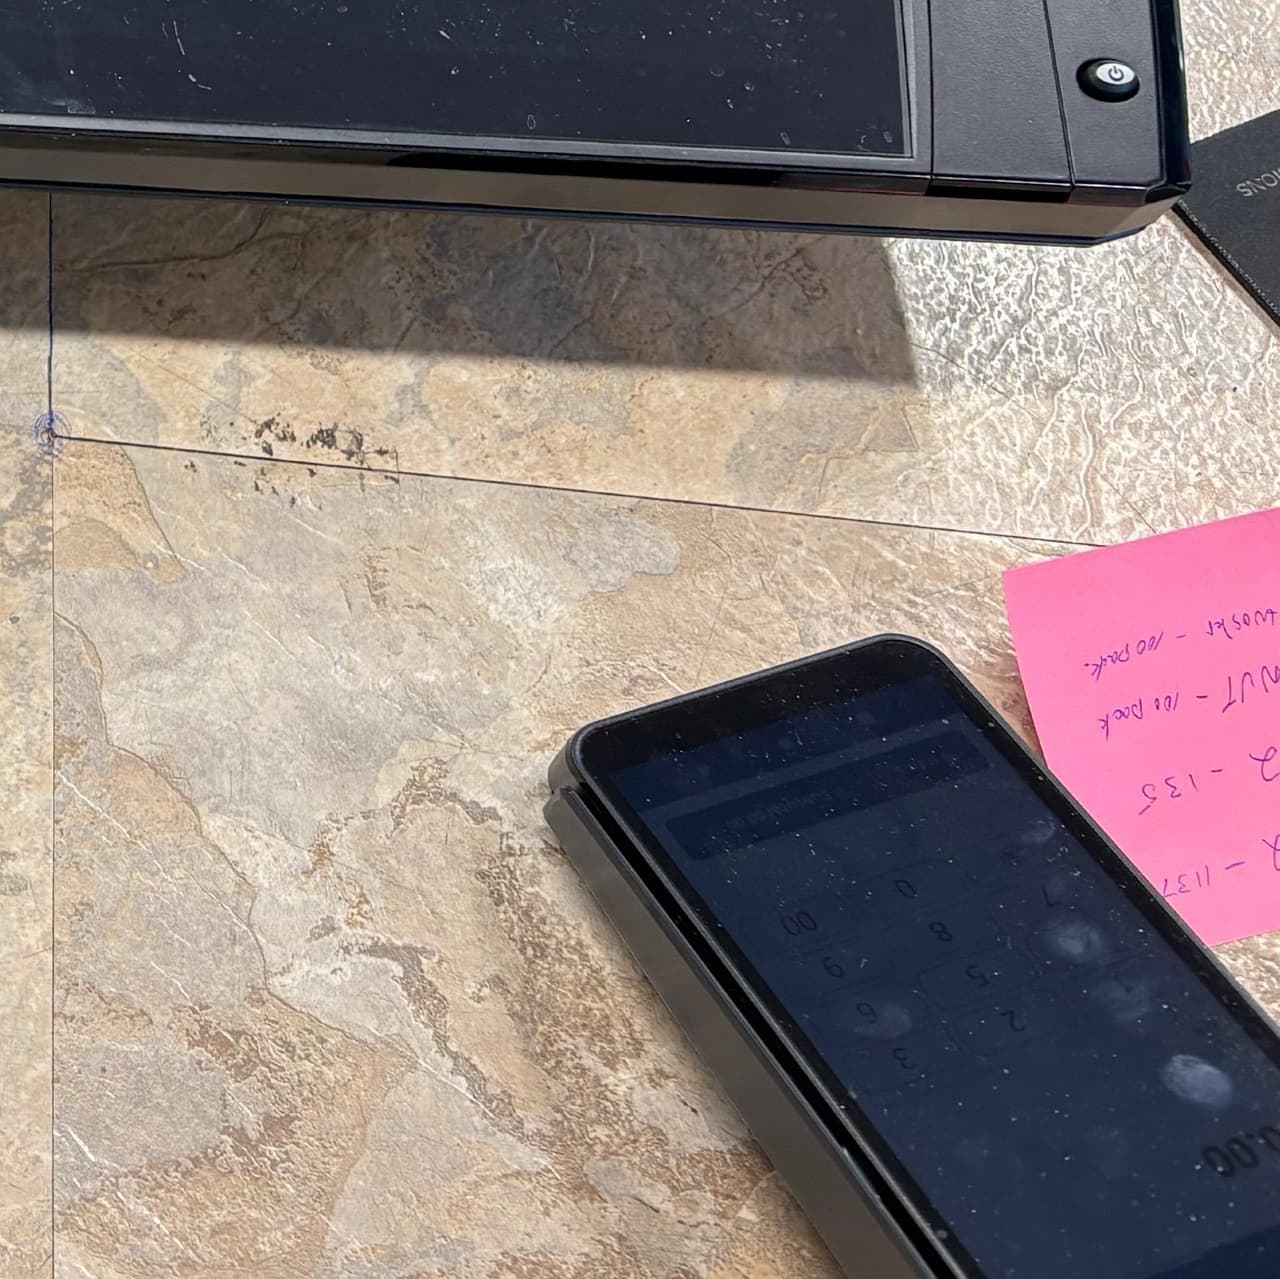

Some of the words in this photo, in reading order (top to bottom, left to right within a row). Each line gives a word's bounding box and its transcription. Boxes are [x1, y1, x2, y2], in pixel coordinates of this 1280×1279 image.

[1137, 632, 1165, 655] 100
[1154, 692, 1179, 713] 100
[1139, 774, 1199, 815] 135
